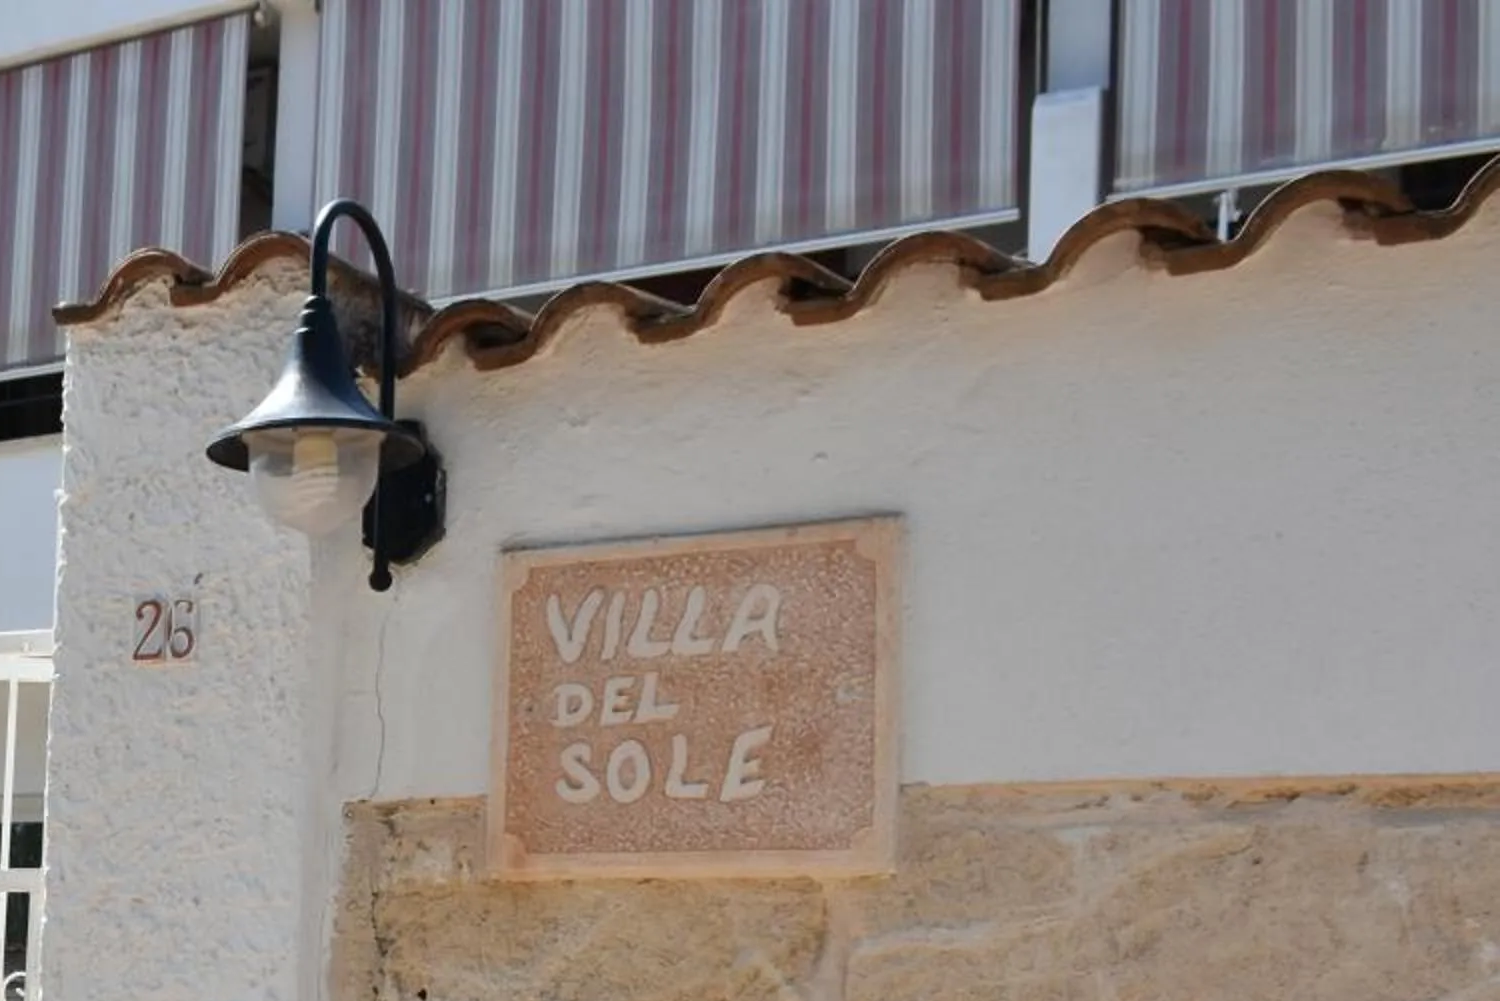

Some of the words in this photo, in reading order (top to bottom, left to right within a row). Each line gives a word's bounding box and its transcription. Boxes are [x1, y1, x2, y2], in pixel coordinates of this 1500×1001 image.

[132, 598, 195, 660] 26
[546, 584, 784, 664] VILLA
[551, 671, 679, 728] DEL
[555, 726, 773, 802] SOLE
